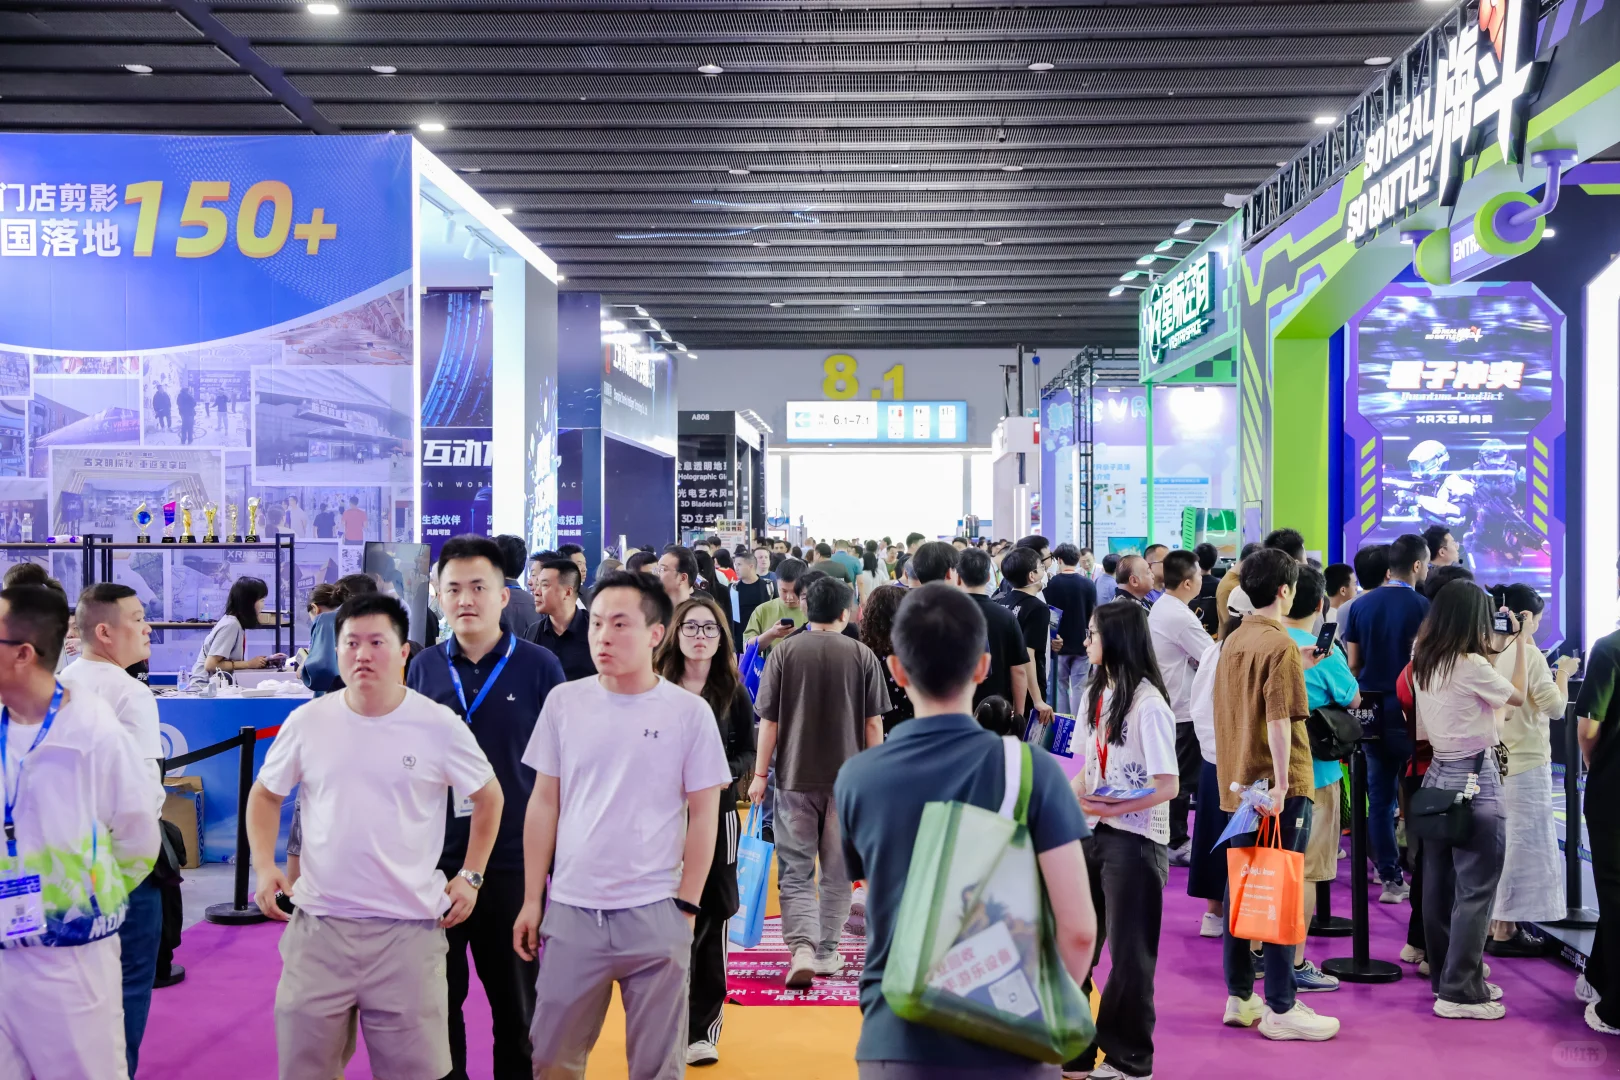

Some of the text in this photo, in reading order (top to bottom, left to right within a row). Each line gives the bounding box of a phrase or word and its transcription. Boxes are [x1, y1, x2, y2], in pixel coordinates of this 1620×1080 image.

[1364, 88, 1434, 180] SO REAL
[0, 182, 118, 213] 门店剪影
[1346, 145, 1432, 243] SO BATTLE
[1, 218, 122, 258] 国落地
[125, 180, 337, 258] 150+
[822, 353, 904, 400] 8.1
[692, 413, 710, 421] A808
